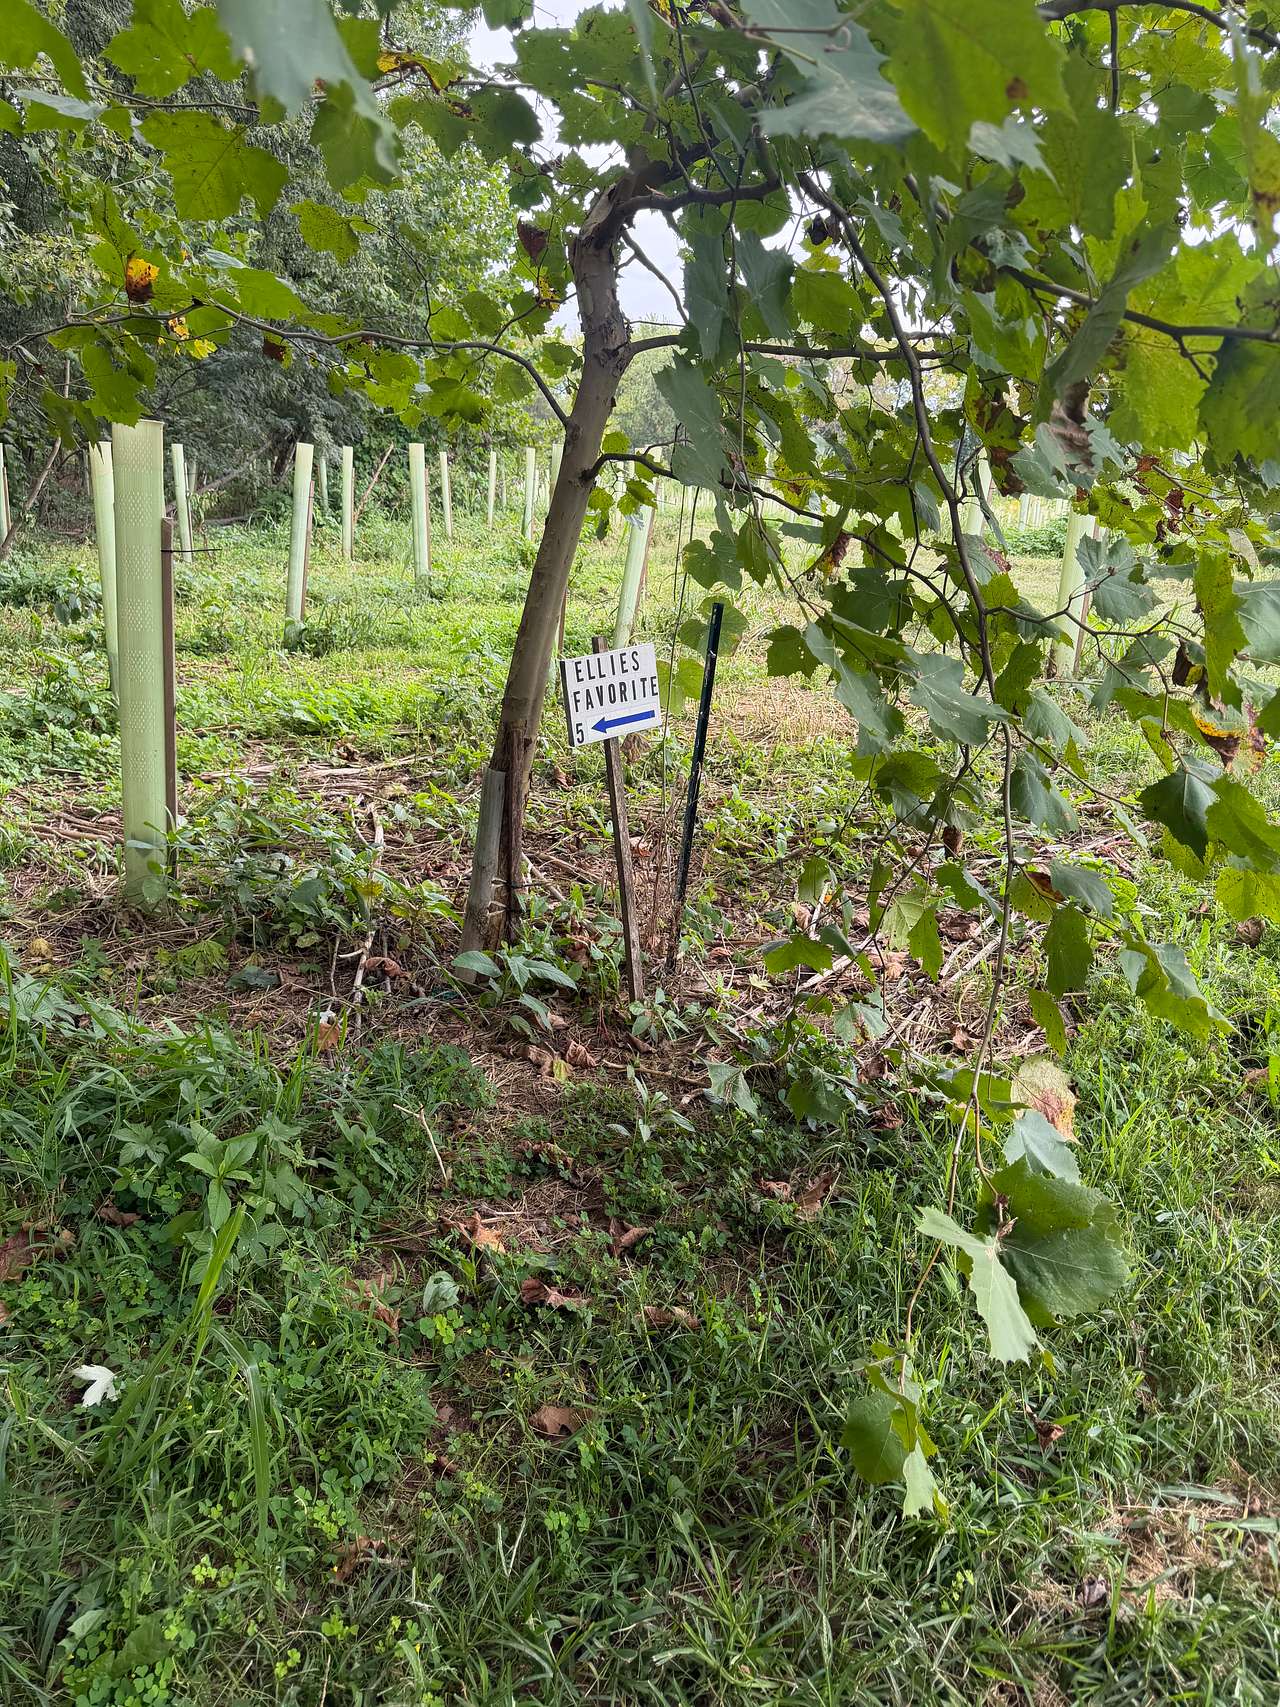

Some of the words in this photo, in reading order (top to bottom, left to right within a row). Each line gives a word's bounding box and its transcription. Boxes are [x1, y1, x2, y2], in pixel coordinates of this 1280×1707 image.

[575, 651, 640, 682] ELLIES
[573, 676, 658, 712] FAVORITE
[575, 723, 584, 743] 5
